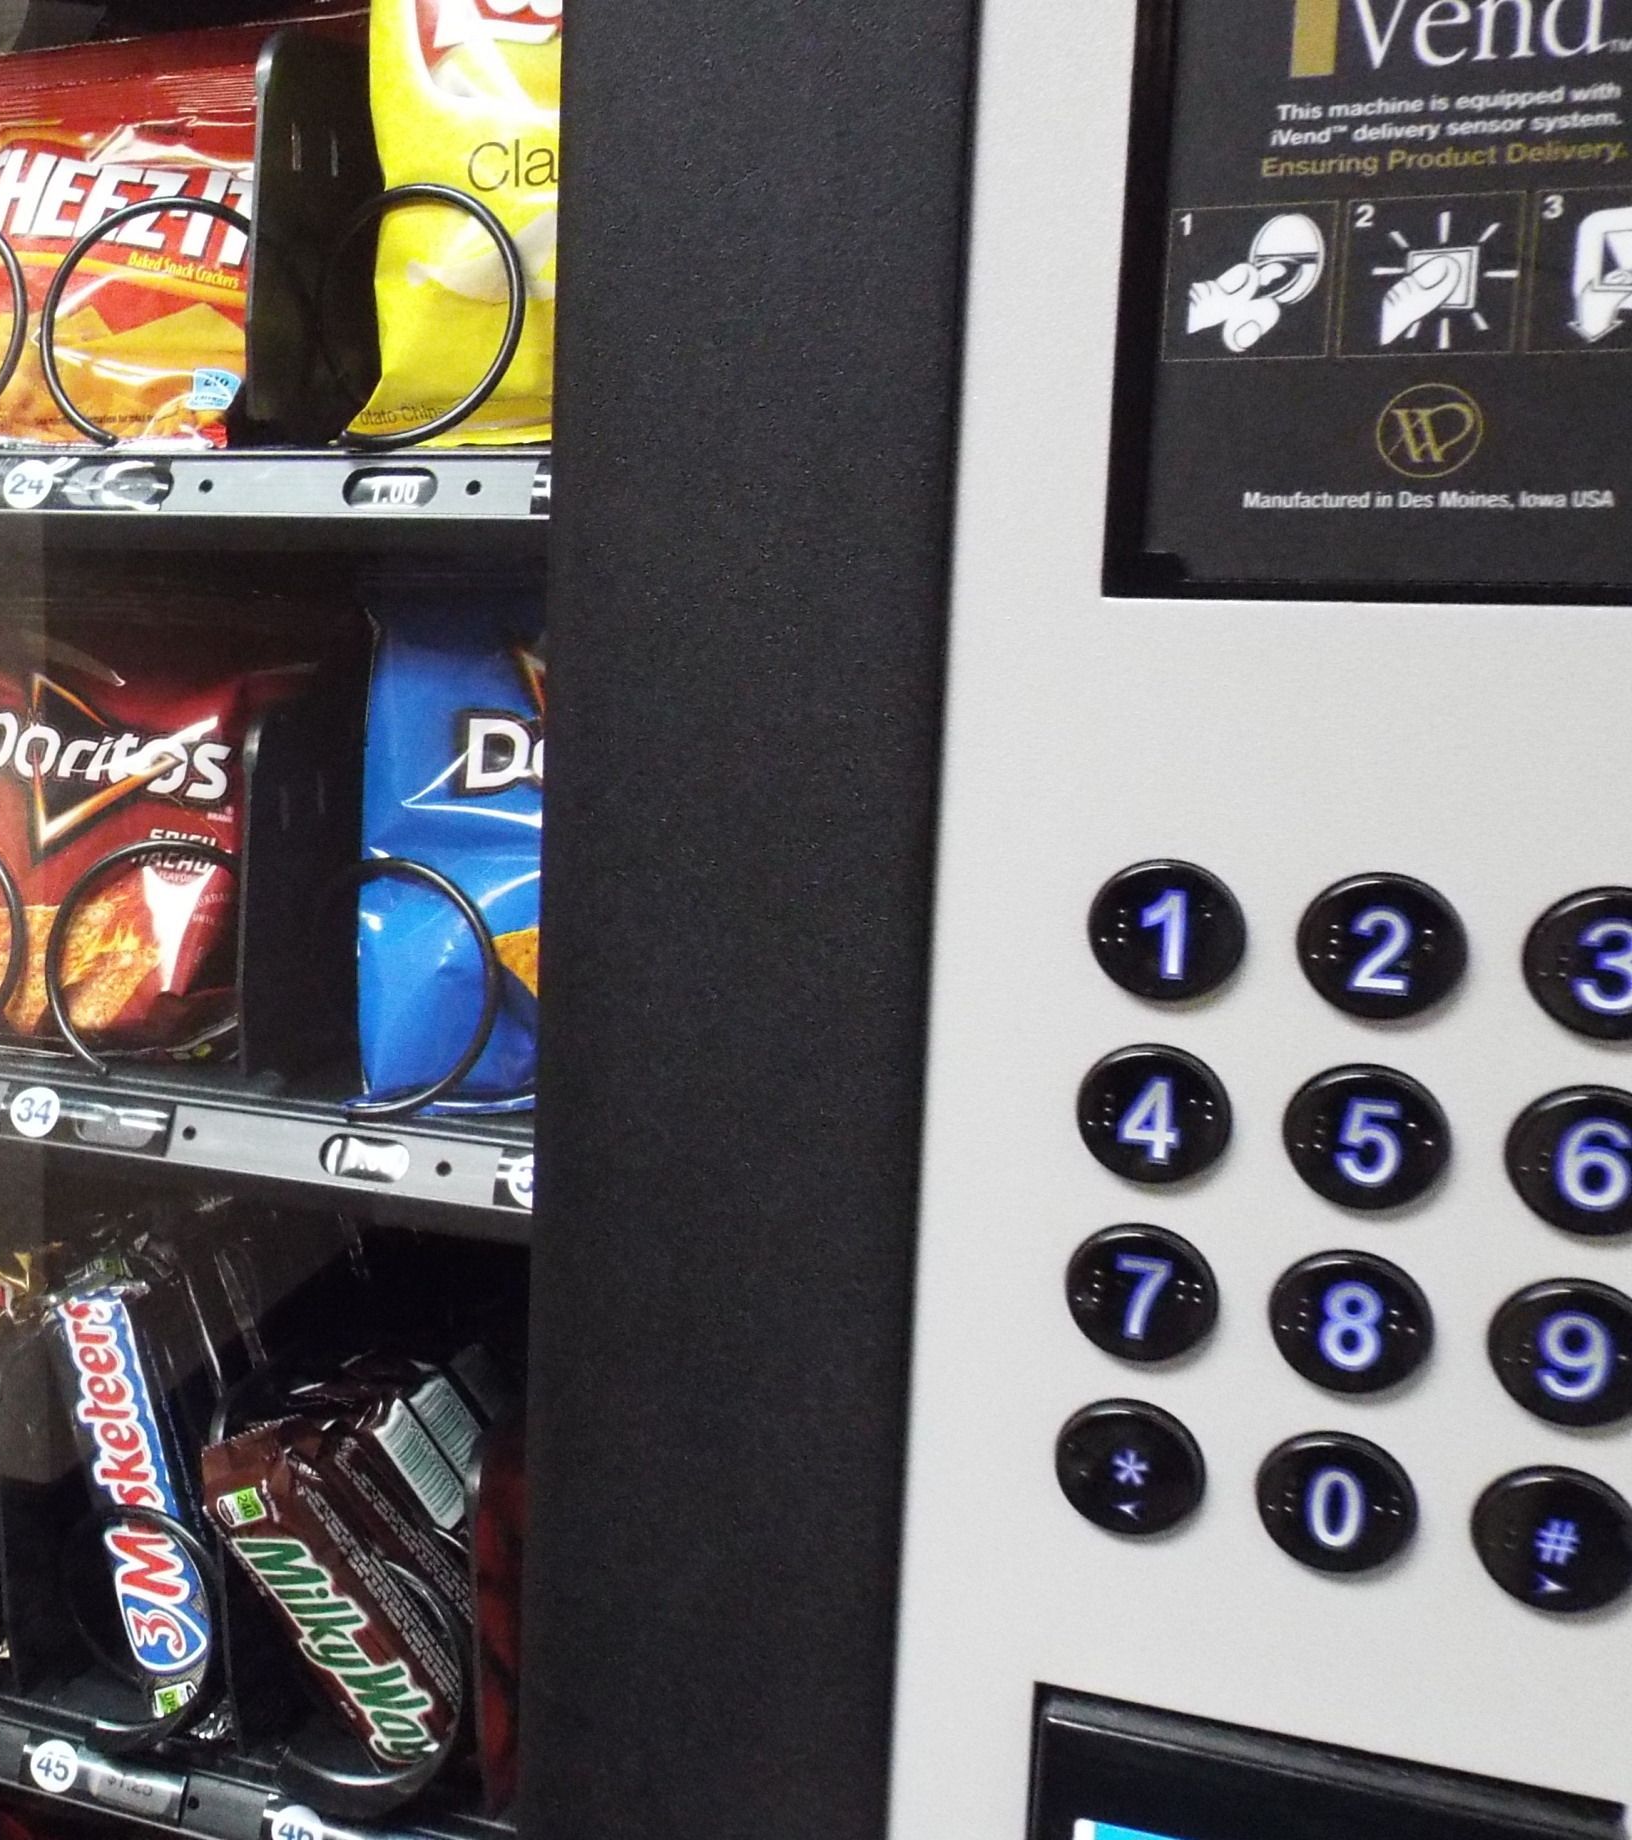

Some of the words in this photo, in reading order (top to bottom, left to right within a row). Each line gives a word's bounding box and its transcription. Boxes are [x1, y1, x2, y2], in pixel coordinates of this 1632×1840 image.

[1277, 105, 1323, 121] This
[1328, 98, 1424, 119] machine
[1430, 94, 1448, 112] is
[1455, 86, 1565, 112] equipped
[1571, 82, 1622, 102] with
[1352, 121, 1440, 143] delivery
[1446, 117, 1524, 136] sensor
[1530, 112, 1623, 133] system.
[1261, 153, 1378, 178] Ensuring
[1388, 145, 1496, 170] Product
[1505, 140, 1628, 165] Delivery.
[1180, 214, 1193, 236] 1
[1355, 205, 1374, 227] 2
[1544, 196, 1564, 219] 3
[128, 250, 163, 270] Baked
[164, 258, 195, 279] Snack
[195, 264, 240, 289] Crackers
[359, 404, 398, 426] otato
[9, 472, 45, 496] 24
[371, 481, 419, 505] 1.00
[1243, 490, 1370, 509] Manufactured
[1375, 490, 1393, 509] in
[1398, 491, 1434, 509] Des
[1438, 491, 1515, 511] Moines,
[1519, 491, 1566, 509] Iowa
[1571, 490, 1615, 509] USA
[465, 718, 544, 789] D
[1142, 889, 1190, 980] 1
[1349, 907, 1411, 994] 2
[1574, 920, 1632, 1011] 3
[16, 1097, 52, 1126] 34
[1119, 1077, 1180, 1163] 4
[1335, 1099, 1402, 1187] 5
[1562, 1119, 1632, 1210] 6
[1117, 1254, 1171, 1339] 7
[1319, 1282, 1382, 1371] 8
[1538, 1312, 1612, 1399] 9
[236, 1493, 255, 1518] 240
[1308, 1469, 1362, 1548] 0
[1534, 1518, 1580, 1566] #
[128, 1608, 187, 1659] 3
[233, 1538, 369, 1671] Milky
[339, 1659, 439, 1763] Way
[36, 1753, 69, 1782] 45
